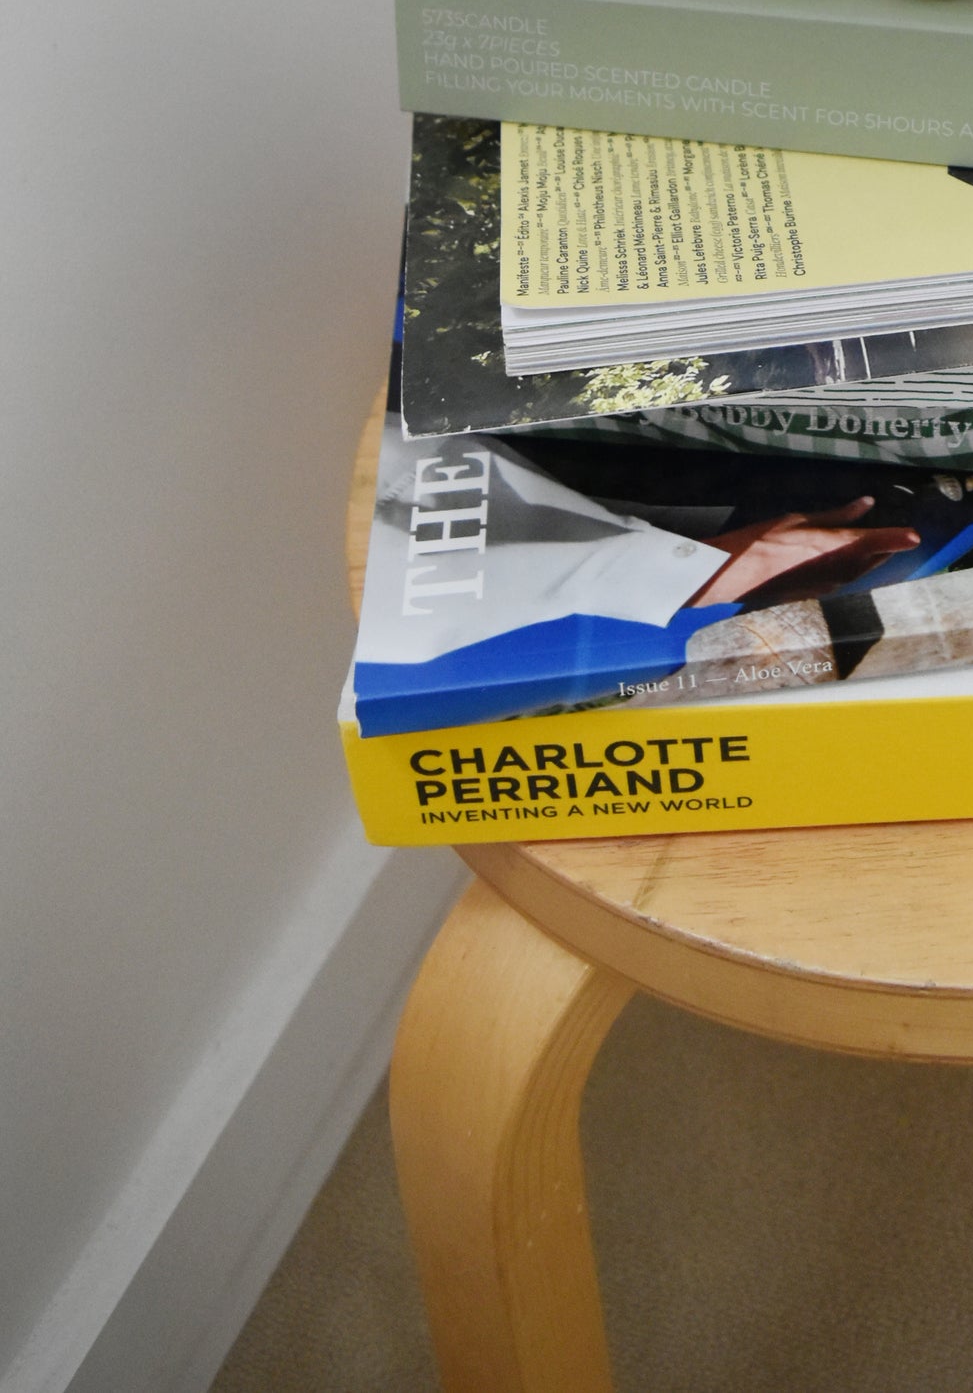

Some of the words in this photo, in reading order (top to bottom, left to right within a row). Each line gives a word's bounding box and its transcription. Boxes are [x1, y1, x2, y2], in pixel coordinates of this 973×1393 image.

[424, 51, 484, 70] HAND
[491, 57, 578, 79] POURED
[584, 65, 680, 90] SCENTED
[686, 75, 772, 98] CANDLE
[426, 70, 501, 92] FILLING
[506, 79, 563, 97] YOUR
[569, 85, 676, 110] MOMENTS
[681, 96, 735, 114] WITH
[741, 101, 809, 122] SCENT
[815, 108, 859, 127] FOR
[517, 159, 529, 184] Jamet
[554, 149, 565, 174] Louise
[591, 161, 602, 183] Nisch
[536, 169, 550, 188] Moju
[572, 167, 584, 190] Chloé
[517, 187, 529, 211] Alexis
[537, 191, 550, 211] Moju
[592, 186, 606, 229] Philotheus
[667, 178, 680, 220] Gaillardon
[726, 194, 738, 226] Paterno
[761, 180, 774, 212] Thomas
[632, 200, 645, 246] Méchineau
[783, 201, 796, 227] Burine
[556, 228, 568, 263] Caranton
[613, 229, 627, 258] Schriek
[652, 216, 666, 264] Saint-Pierre
[671, 223, 683, 243] Elliot
[692, 225, 705, 261] Lefebvre
[728, 228, 744, 261] Victoria
[748, 217, 765, 261] Puig-Serra
[576, 250, 590, 273] Quine
[634, 248, 648, 281] Léonard
[787, 230, 806, 276] Christophe
[517, 257, 529, 296] Manifeste
[557, 266, 569, 294] Pauline
[577, 275, 589, 293] Nick
[616, 260, 629, 291] Melissa
[657, 267, 668, 287] Anna
[695, 263, 708, 284] Jules
[754, 263, 767, 280] Rita
[806, 406, 972, 448] Doherty
[402, 452, 490, 616] THE
[618, 682, 670, 698] Issue
[734, 667, 781, 683] Aloe
[787, 659, 834, 676] Vera
[409, 735, 750, 776] CHARLOTTE
[415, 767, 705, 807] PERRIAND
[421, 805, 558, 825] INVENTING
[567, 804, 584, 817] A
[593, 800, 650, 815] NEW
[660, 796, 753, 813] WORLD
